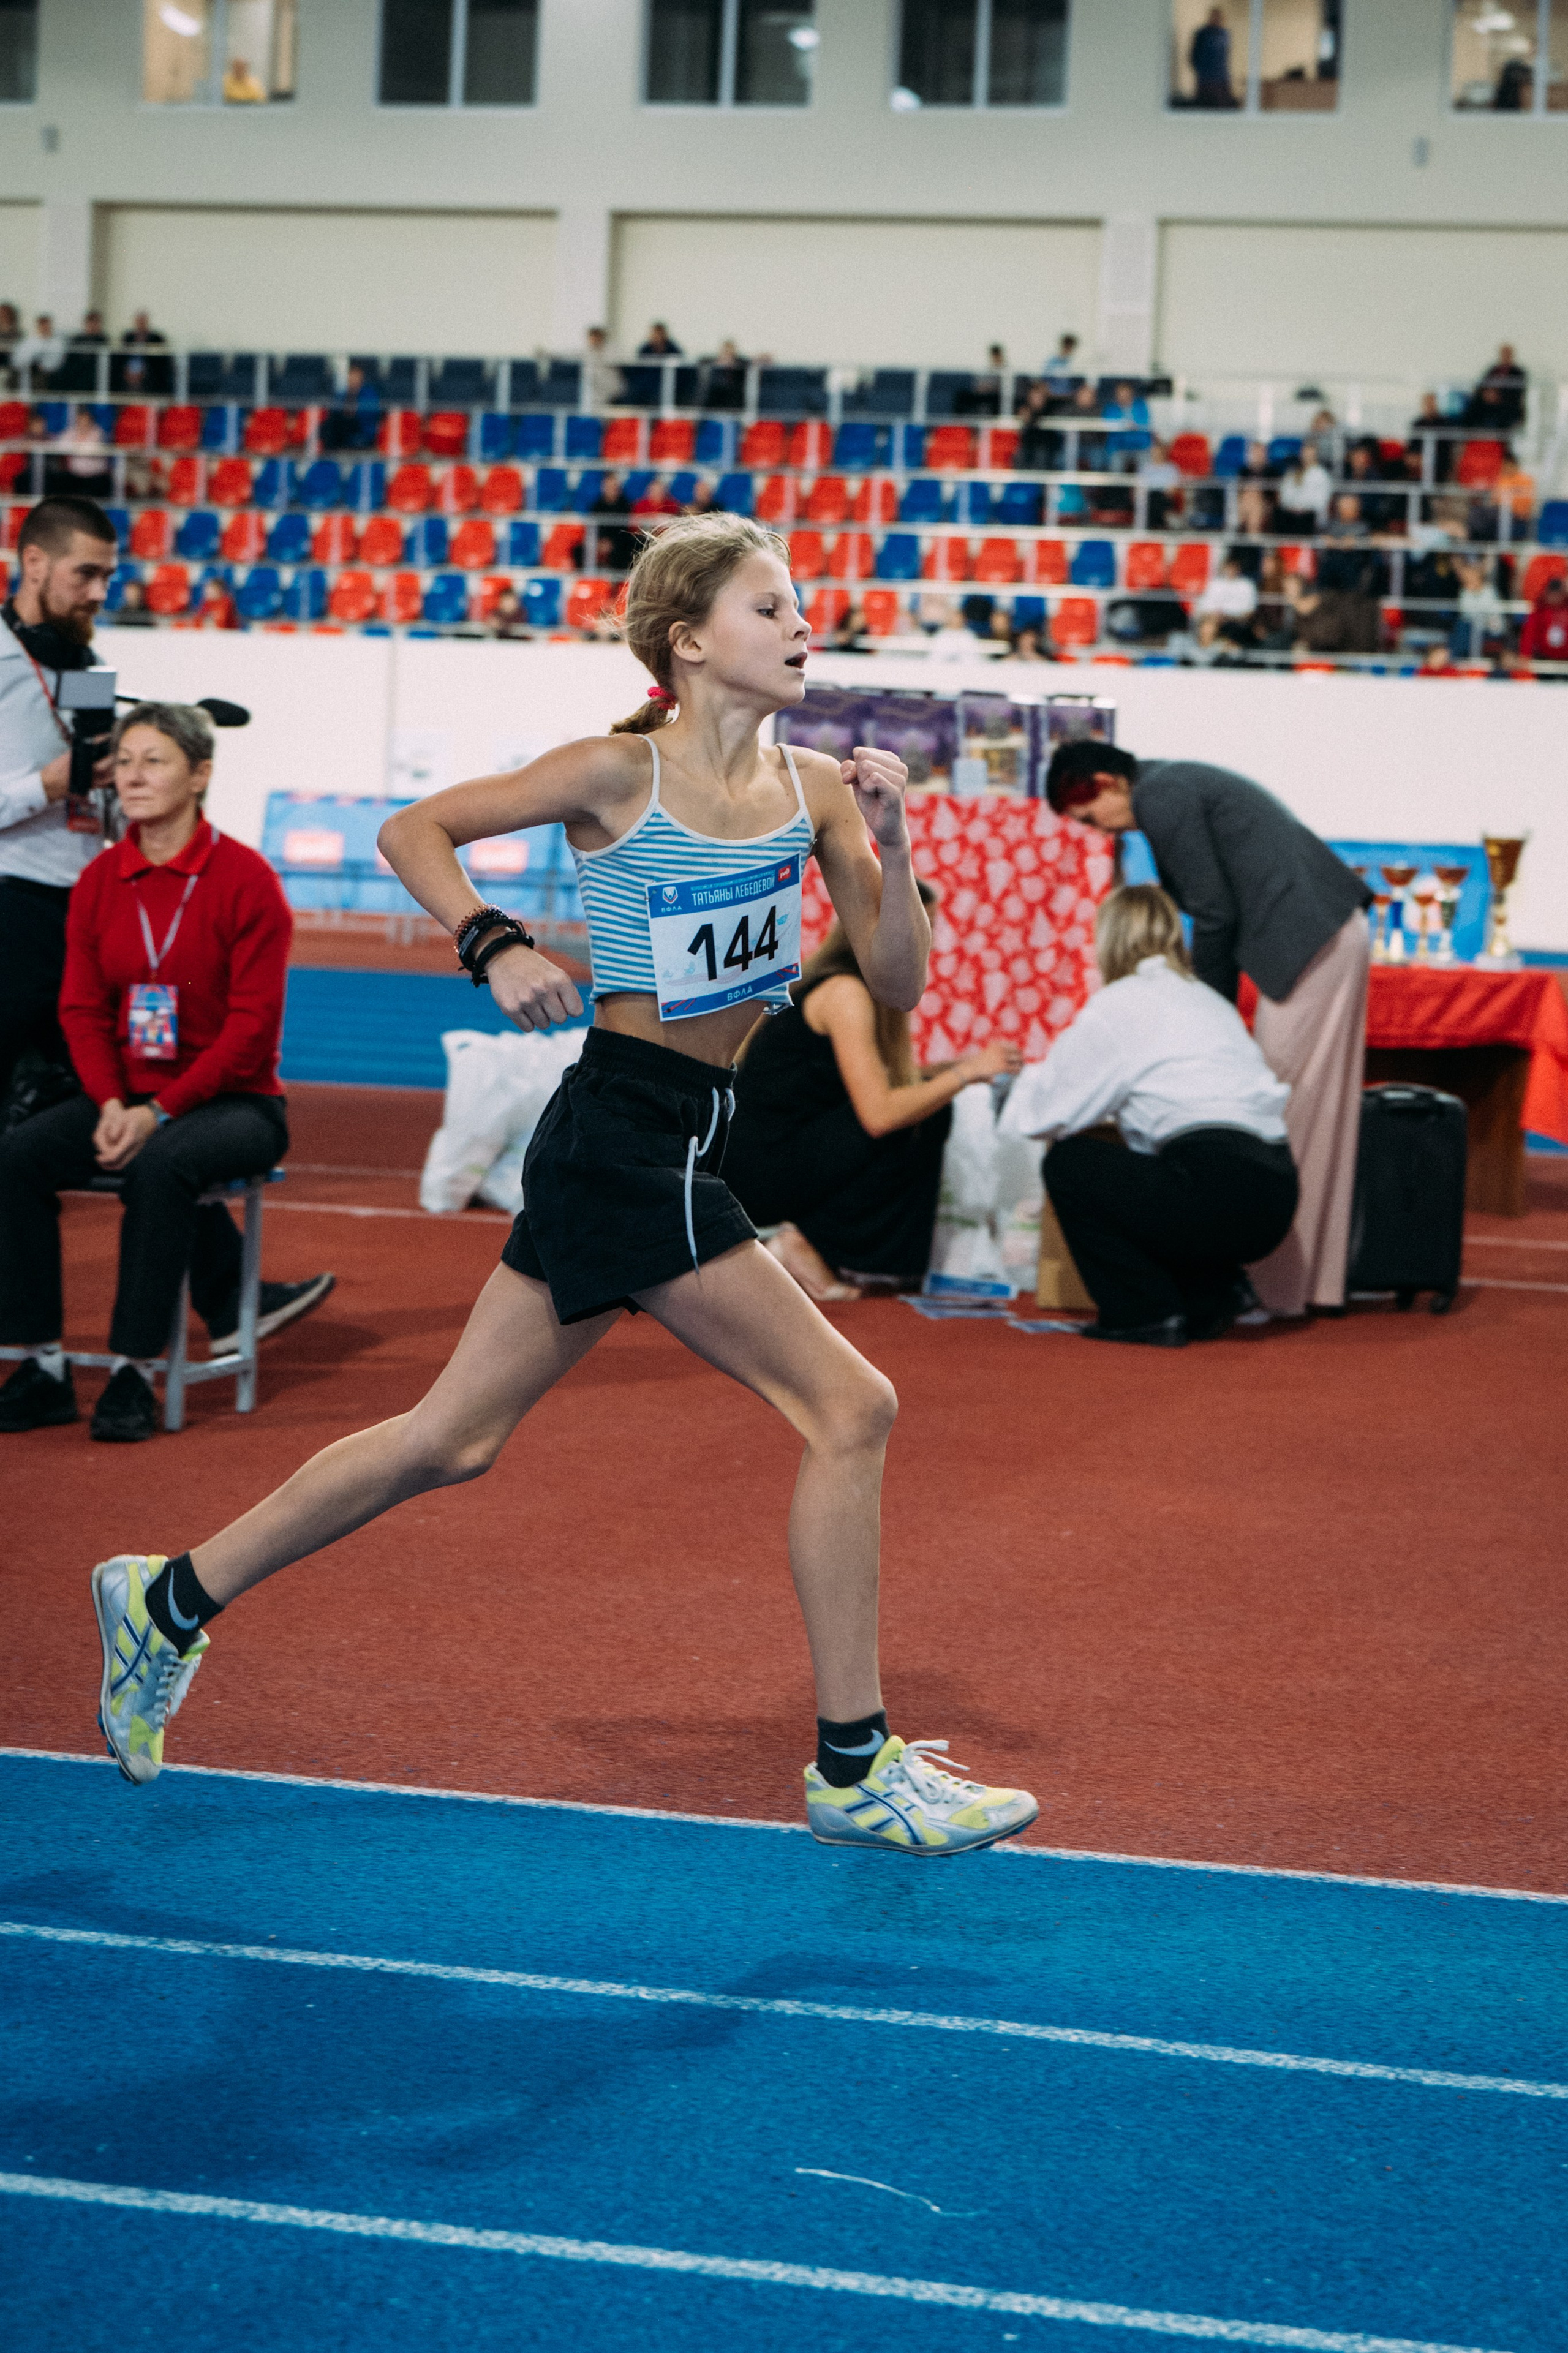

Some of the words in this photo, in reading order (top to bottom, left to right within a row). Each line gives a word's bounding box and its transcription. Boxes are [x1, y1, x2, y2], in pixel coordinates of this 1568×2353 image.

[691, 887, 733, 906] ТАТЬЯНЫ
[735, 873, 775, 898] ЛЕБЕДЕВОЙ
[687, 905, 779, 981] 144
[727, 985, 753, 1001] ВФЛА
